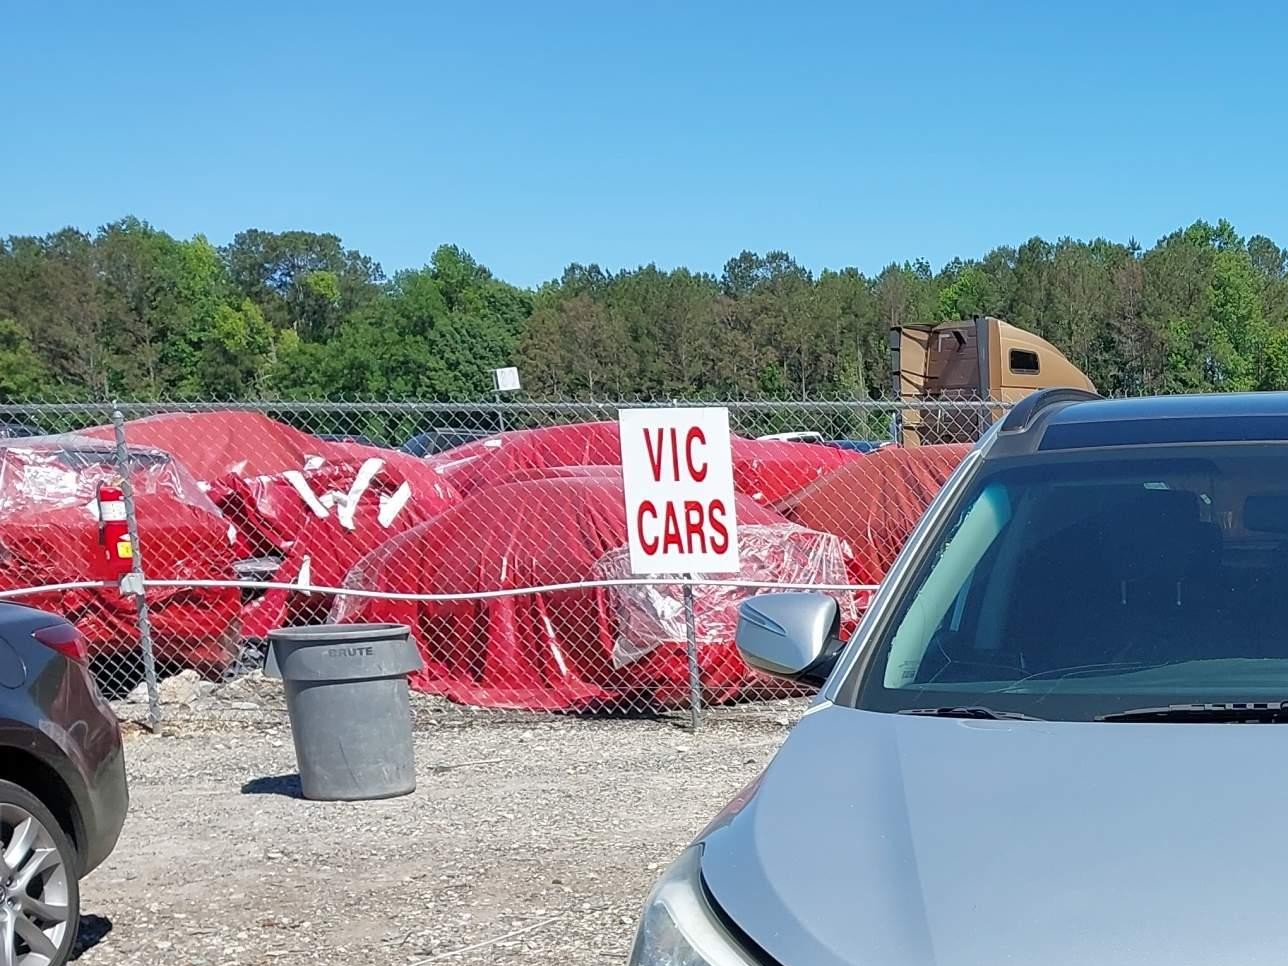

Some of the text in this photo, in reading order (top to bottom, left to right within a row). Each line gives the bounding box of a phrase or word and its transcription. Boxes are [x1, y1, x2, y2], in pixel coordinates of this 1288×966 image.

[643, 426, 708, 482] VIC
[637, 499, 729, 555] CARS
[328, 646, 374, 657] BRUTE
